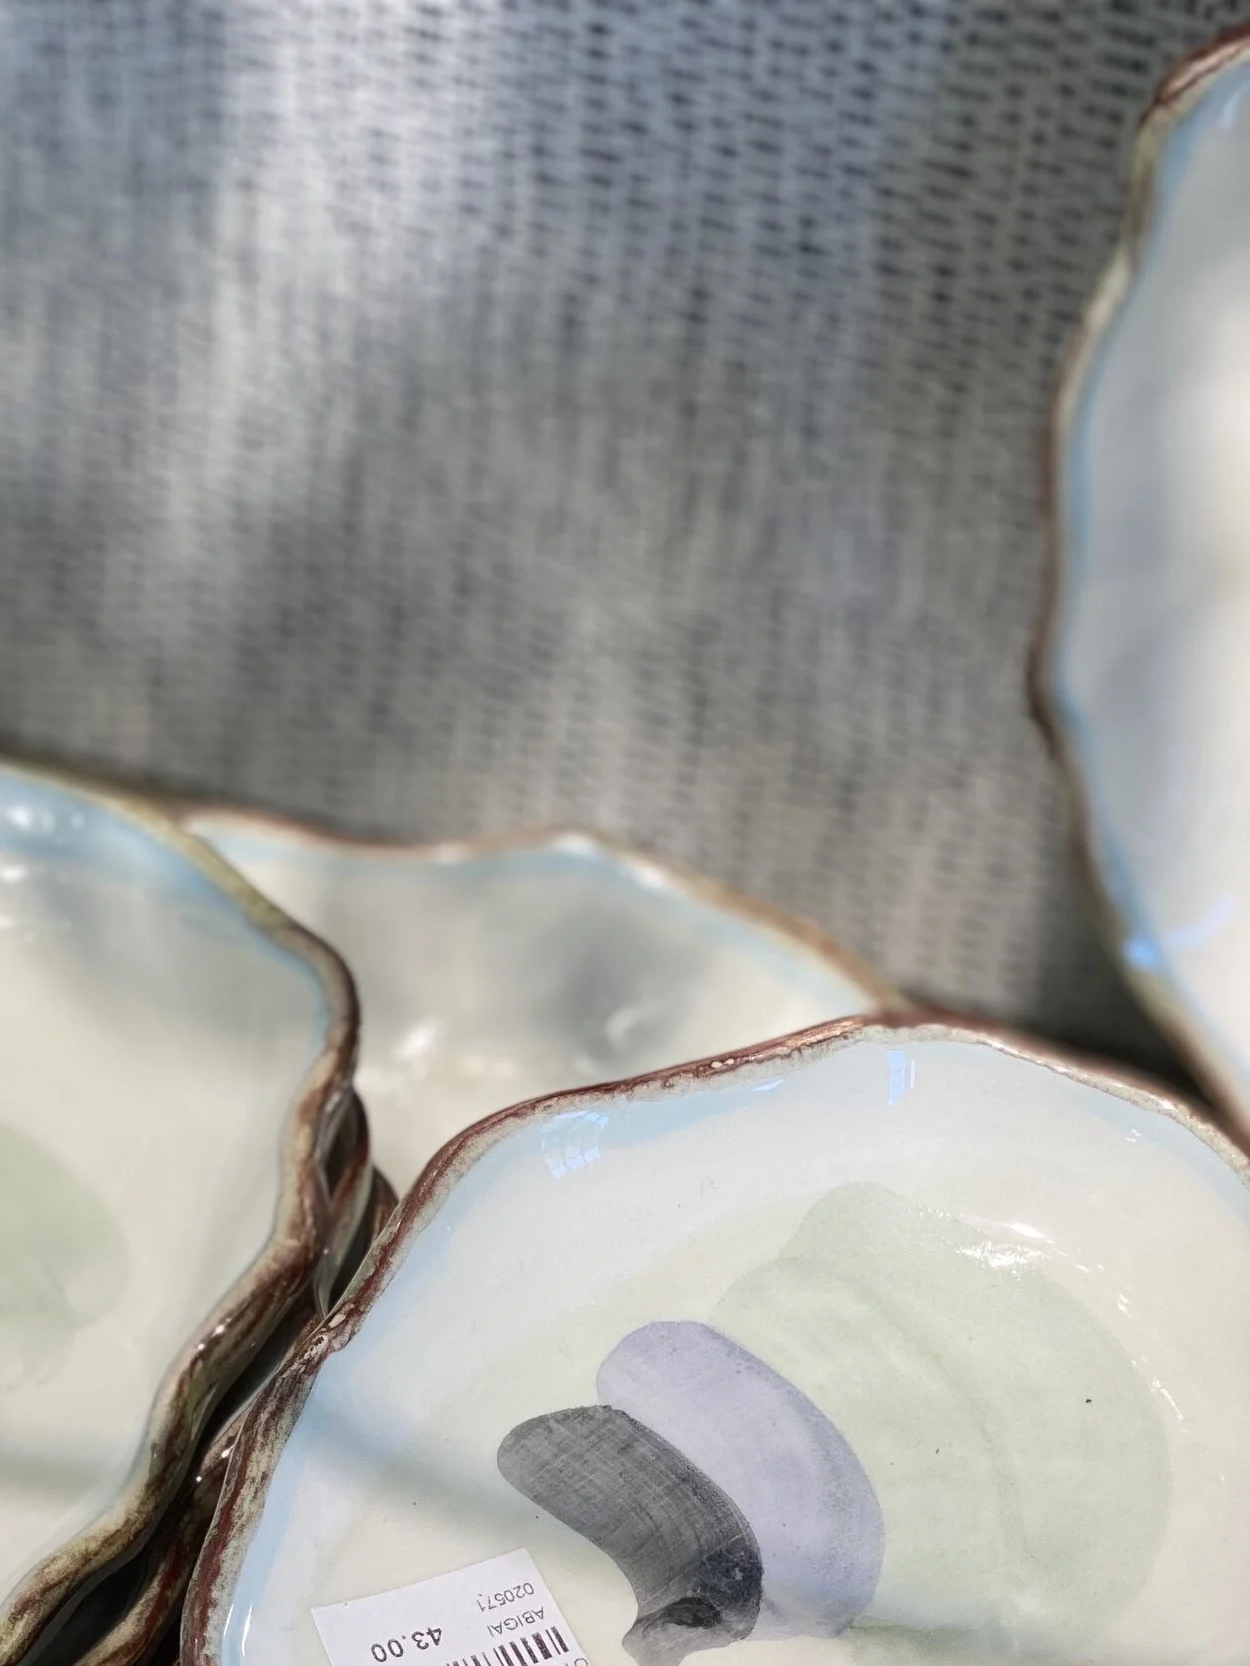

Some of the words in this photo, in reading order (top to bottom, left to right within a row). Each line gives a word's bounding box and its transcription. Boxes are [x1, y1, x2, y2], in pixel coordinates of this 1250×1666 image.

[476, 1581, 535, 1613] 020571
[486, 1605, 545, 1637] ABIGAI
[371, 1626, 443, 1663] 43.00
